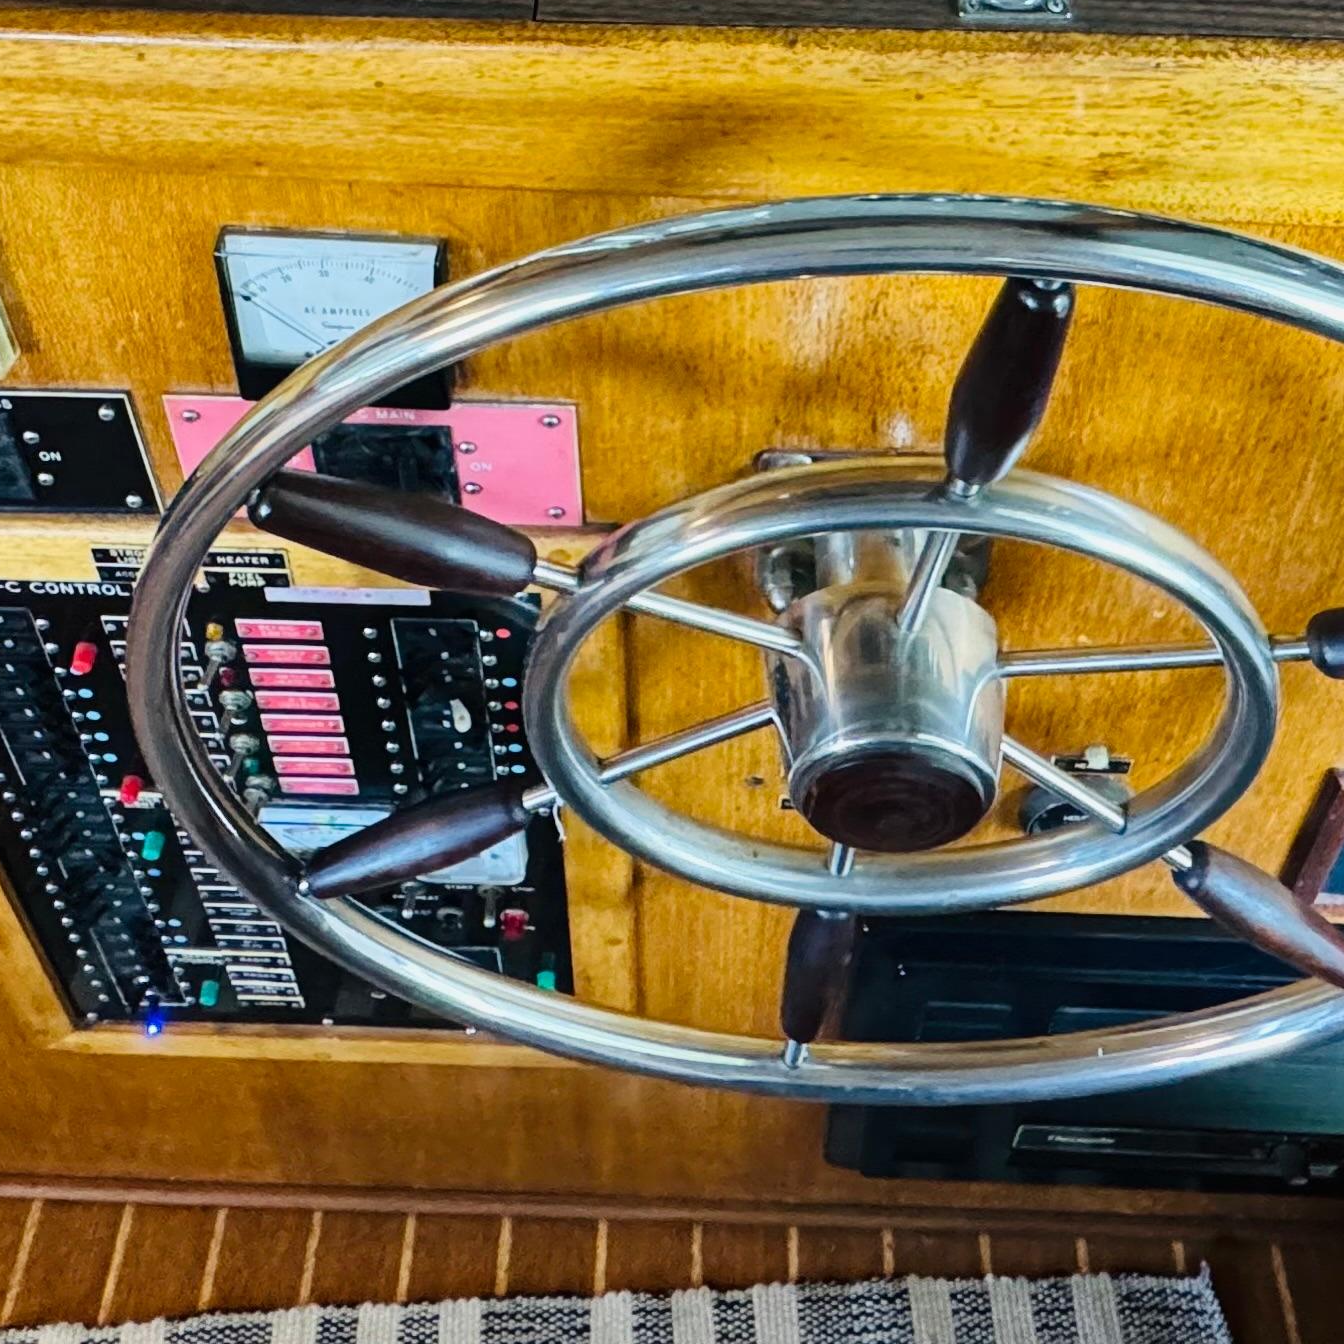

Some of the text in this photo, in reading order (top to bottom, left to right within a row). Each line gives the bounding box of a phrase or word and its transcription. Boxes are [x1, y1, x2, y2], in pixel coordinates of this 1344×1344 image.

[321, 307, 371, 317] AMPERES
[375, 409, 416, 421] MAIN
[38, 451, 62, 462] ON
[469, 461, 493, 472] ON
[216, 555, 270, 565] HEATER
[228, 572, 262, 580] FUEL
[229, 578, 267, 587] PUMP
[28, 582, 131, 597] CONTROL
